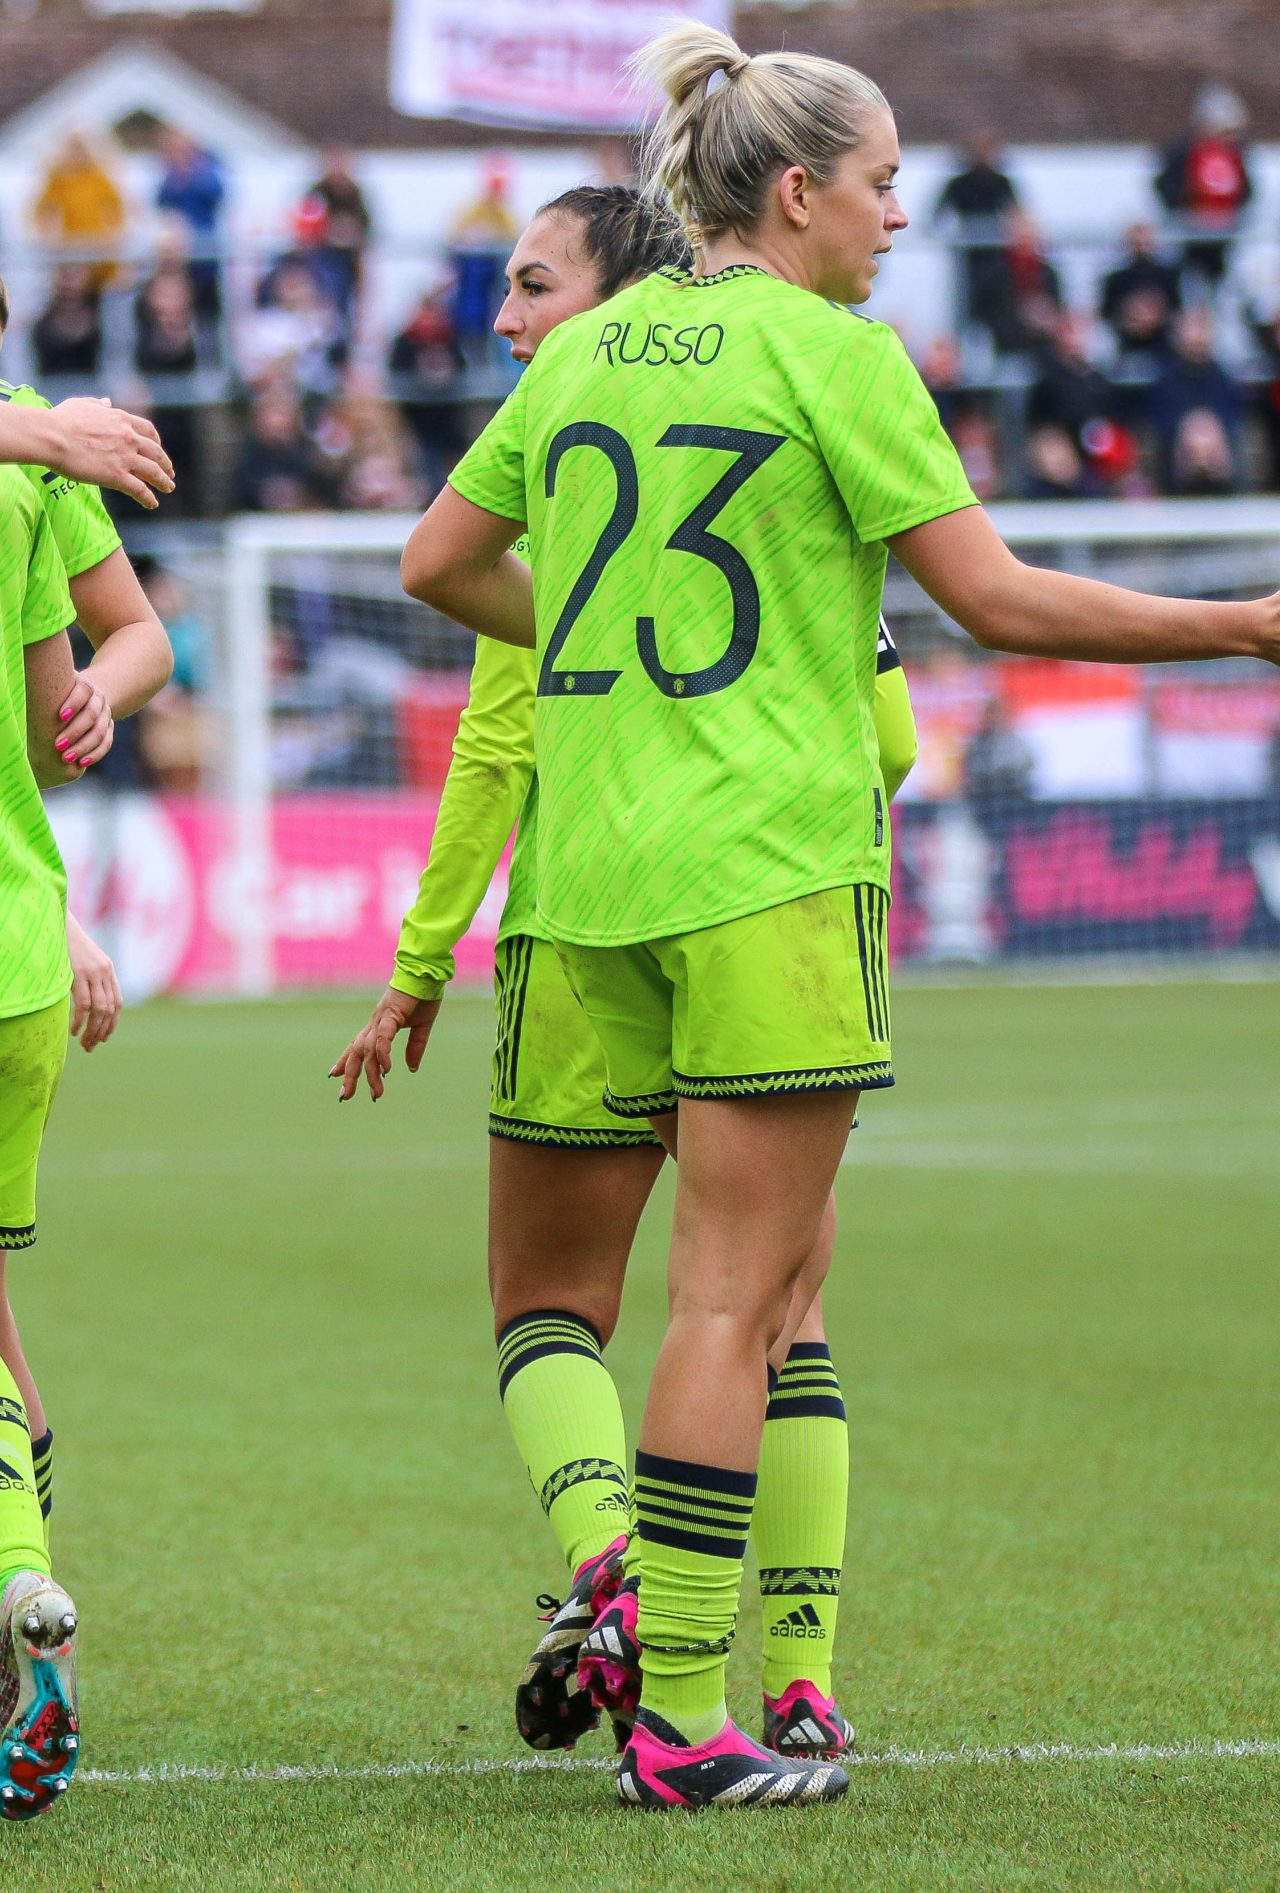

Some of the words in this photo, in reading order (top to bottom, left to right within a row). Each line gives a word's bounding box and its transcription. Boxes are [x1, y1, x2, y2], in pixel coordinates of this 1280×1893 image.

[592, 322, 725, 367] RUSSO
[49, 479, 80, 501] TEC
[536, 420, 790, 699] 23
[770, 1623, 827, 1640] adidas
